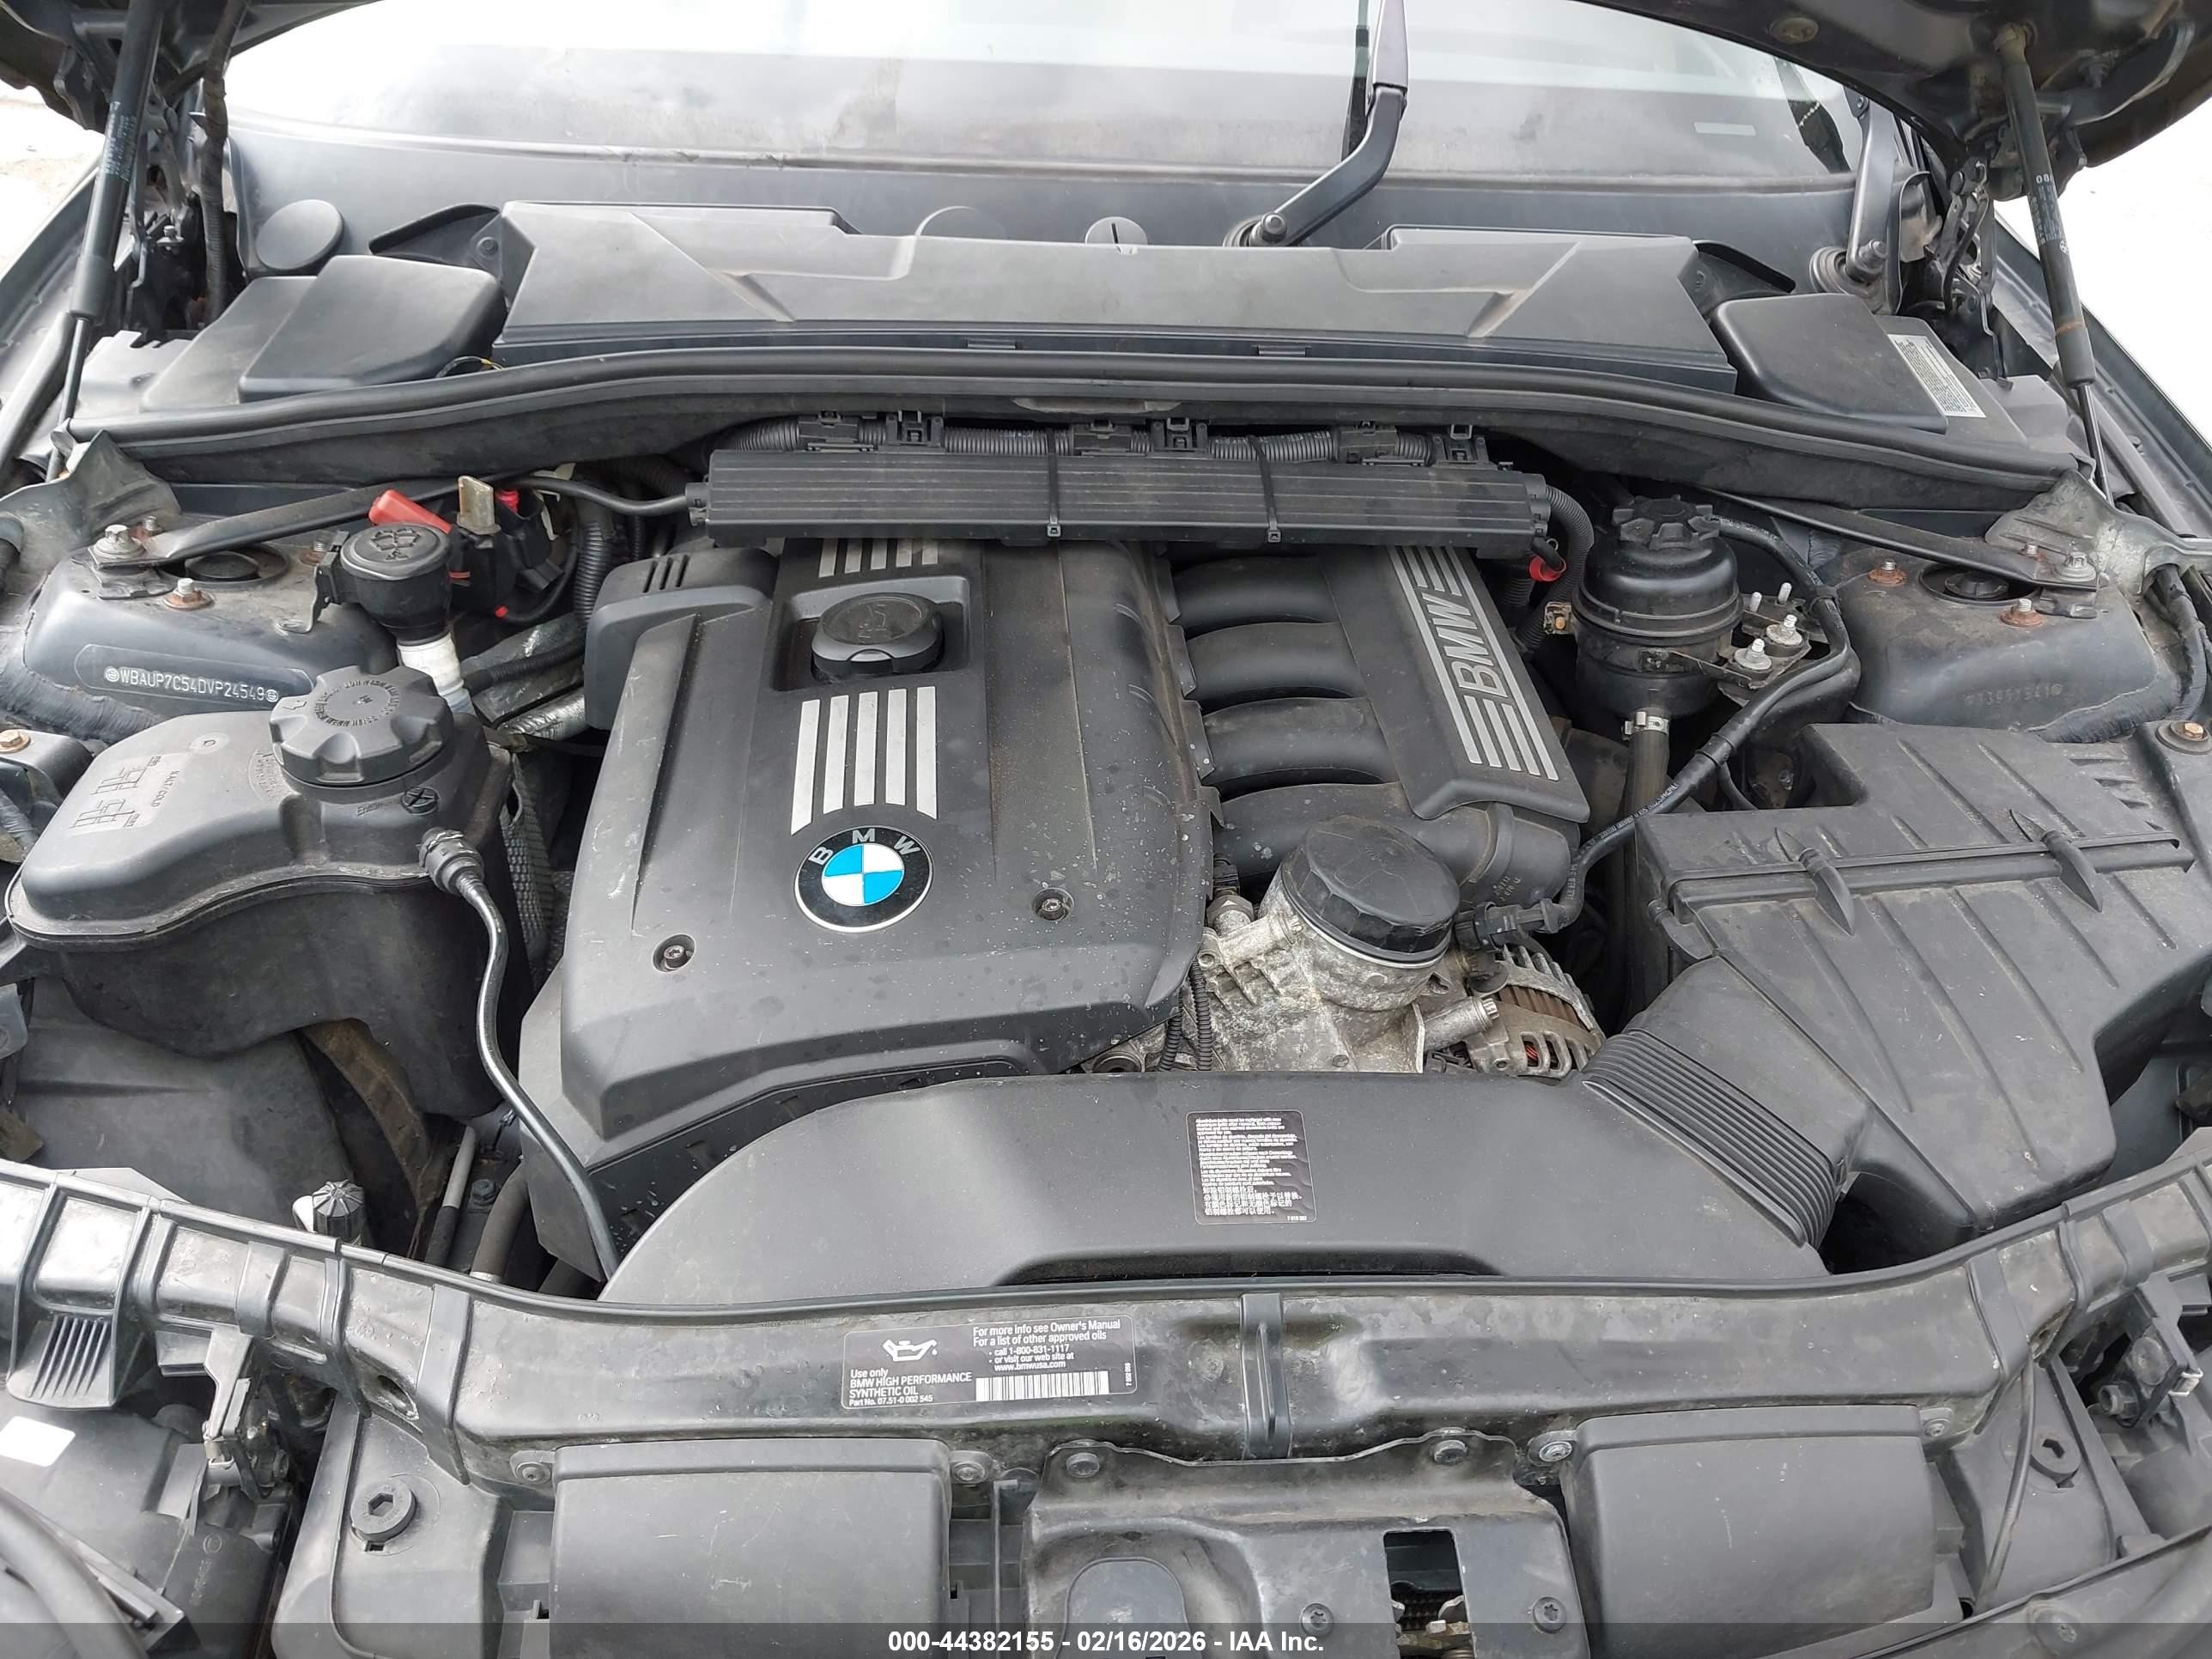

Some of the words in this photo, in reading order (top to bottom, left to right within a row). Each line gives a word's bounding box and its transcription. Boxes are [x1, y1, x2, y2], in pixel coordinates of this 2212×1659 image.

[1422, 592, 1509, 698] BMW
[119, 669, 265, 701] WBAUP7C54DVP24549
[808, 828, 921, 866] BMW
[973, 1327, 988, 1336] For
[989, 1327, 1012, 1335] more
[1014, 1324, 1031, 1334] info
[1033, 1324, 1048, 1333] see
[1050, 1321, 1086, 1332] Owner's
[1088, 1319, 1120, 1330] Manual
[973, 1337, 988, 1346] For
[997, 1335, 1011, 1346] list
[1012, 1334, 1022, 1344] of
[1023, 1334, 1047, 1343] other
[1048, 1331, 1090, 1343] approved
[1091, 1330, 1106, 1340] oils
[994, 1347, 1007, 1356] call
[1008, 1344, 1070, 1355] 1-800-831-1117
[850, 1369, 867, 1378] Use
[869, 1368, 889, 1379] only
[994, 1361, 1066, 1371] www.bmwusa.com
[850, 1378, 874, 1389] BMW
[876, 1376, 899, 1387] HIGH
[901, 1372, 972, 1385] PERFORMANCE
[849, 1387, 902, 1398] SYNTHETIC
[903, 1386, 920, 1395] OIL
